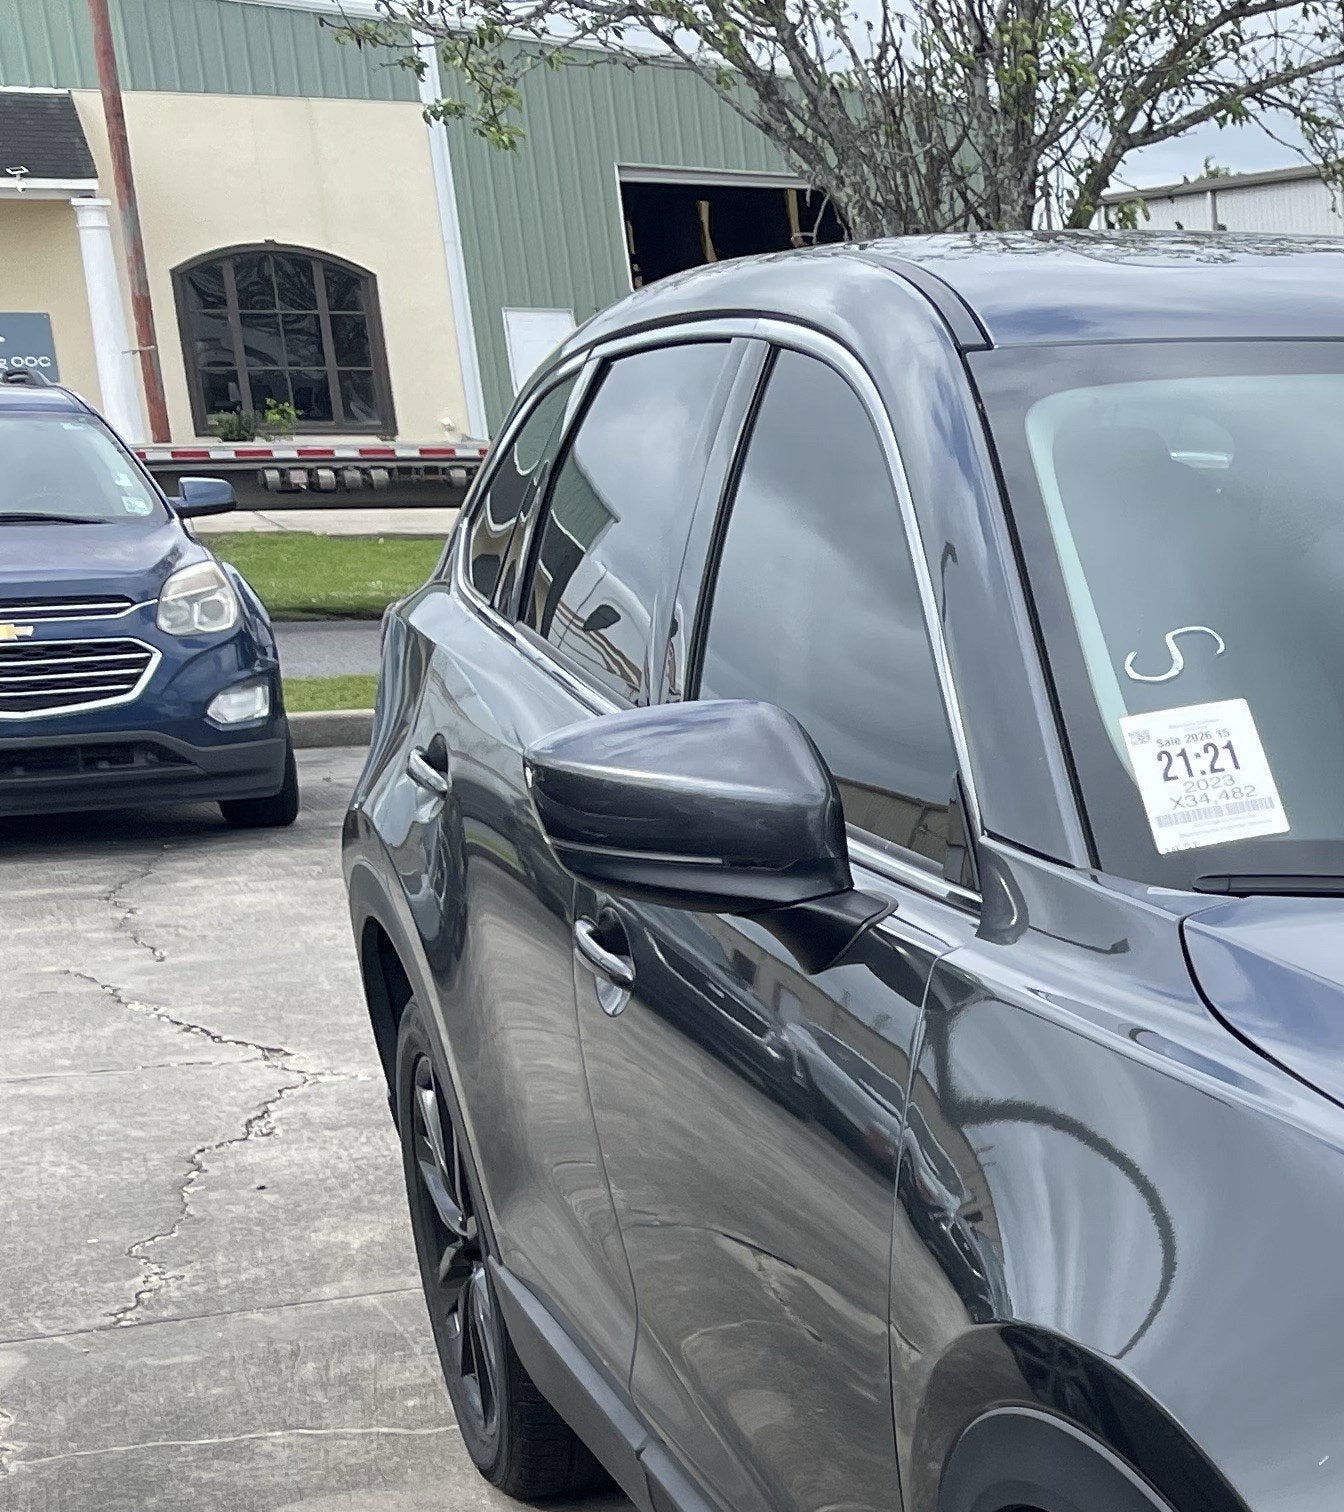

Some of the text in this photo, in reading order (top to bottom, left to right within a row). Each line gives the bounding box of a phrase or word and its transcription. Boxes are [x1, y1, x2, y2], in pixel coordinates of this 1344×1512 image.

[1156, 740, 1241, 782] 21:21
[1183, 774, 1236, 793] 2023
[1169, 784, 1258, 810] X34,482
